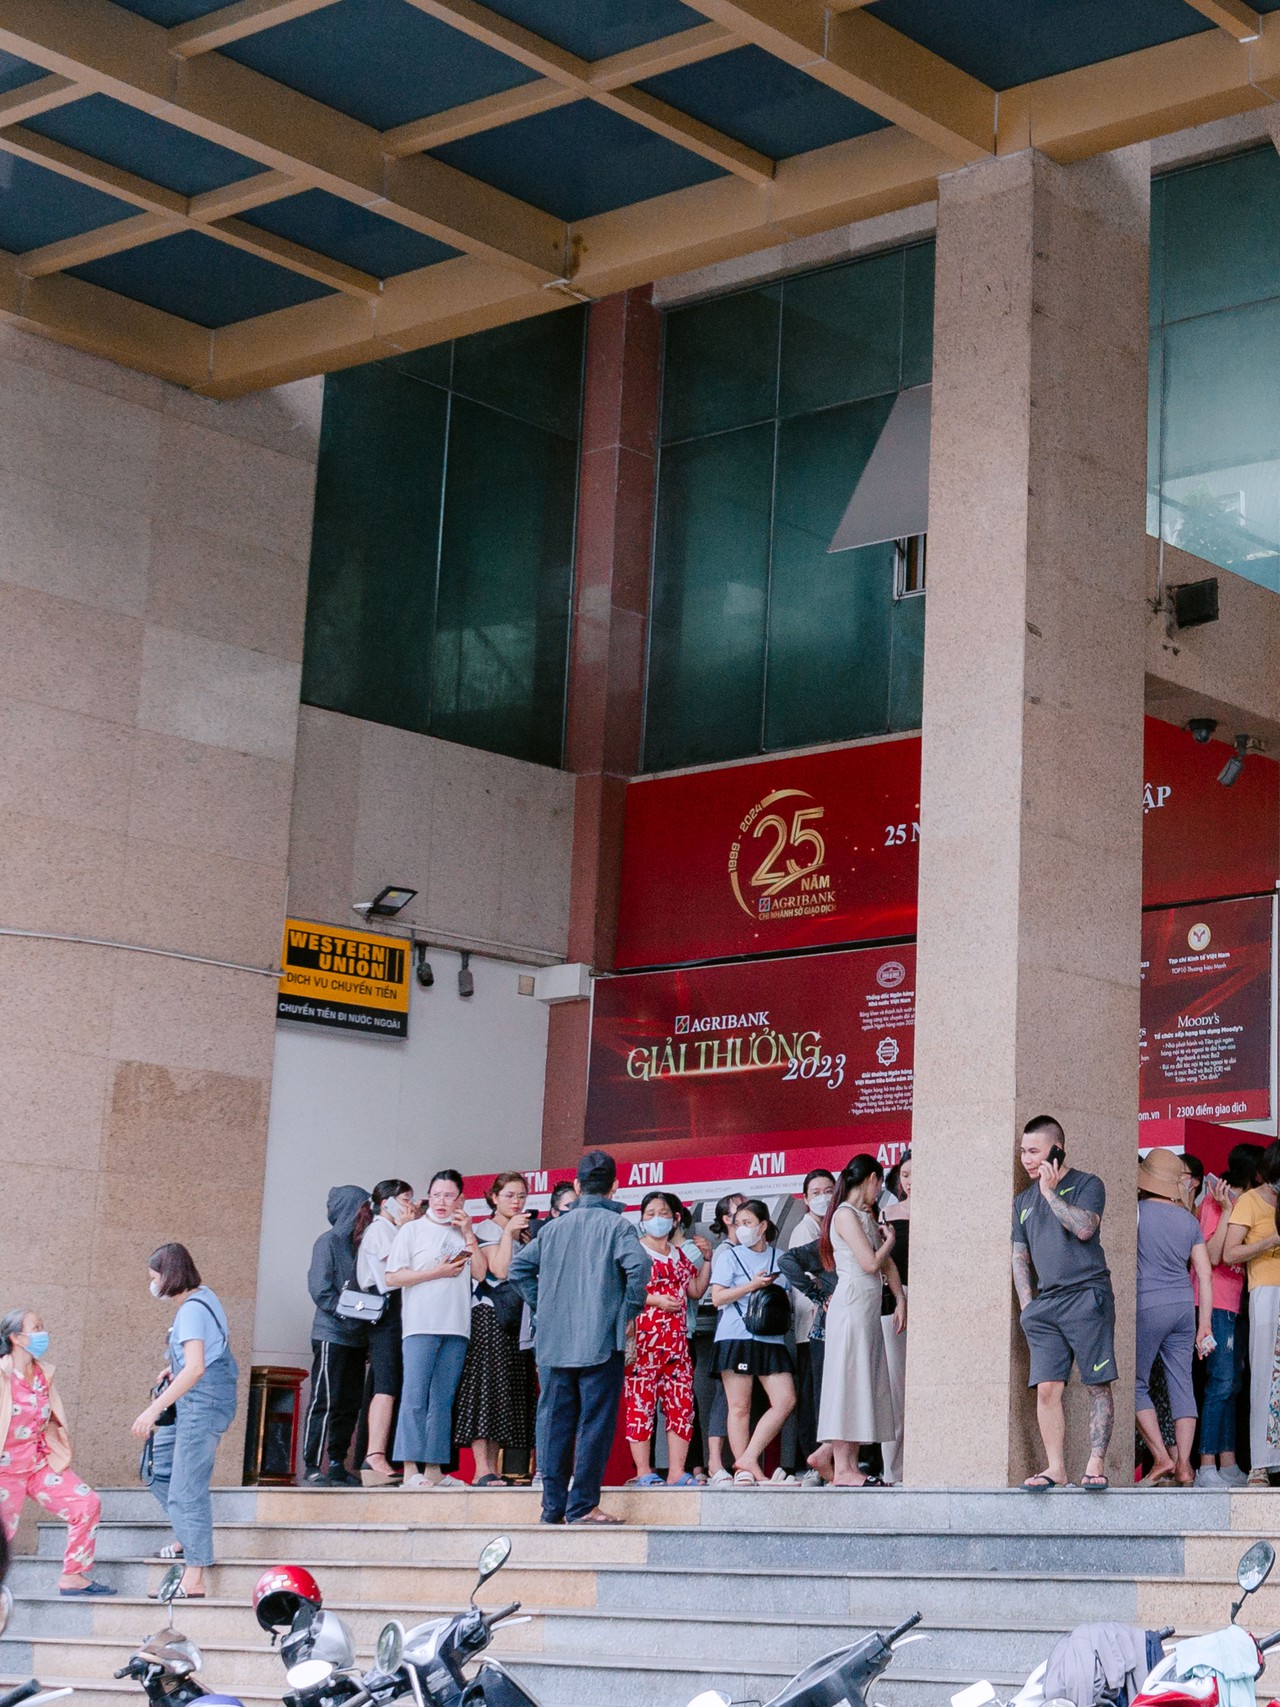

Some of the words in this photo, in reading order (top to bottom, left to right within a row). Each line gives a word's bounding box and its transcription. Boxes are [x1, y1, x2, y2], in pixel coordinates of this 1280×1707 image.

[1143, 783, 1171, 814] ẬP
[751, 806, 826, 886] 25
[885, 824, 906, 846] 25
[801, 874, 830, 891] NĂM
[771, 891, 836, 910] AGRIBANK
[290, 931, 385, 962] WESTERN
[319, 953, 384, 979] UNION
[690, 1011, 770, 1032] AGRIBANK
[626, 1037, 688, 1082] GIẢI
[694, 1027, 822, 1070] THƯỞNG
[782, 1053, 847, 1089] 2023
[1177, 1107, 1195, 1118] 2300
[1195, 1103, 1214, 1116] điểm
[1215, 1104, 1231, 1117] giao
[1231, 1101, 1247, 1115] dịch
[628, 1162, 663, 1185] ATM
[749, 1152, 785, 1176] ATM
[525, 1171, 548, 1192] TM
